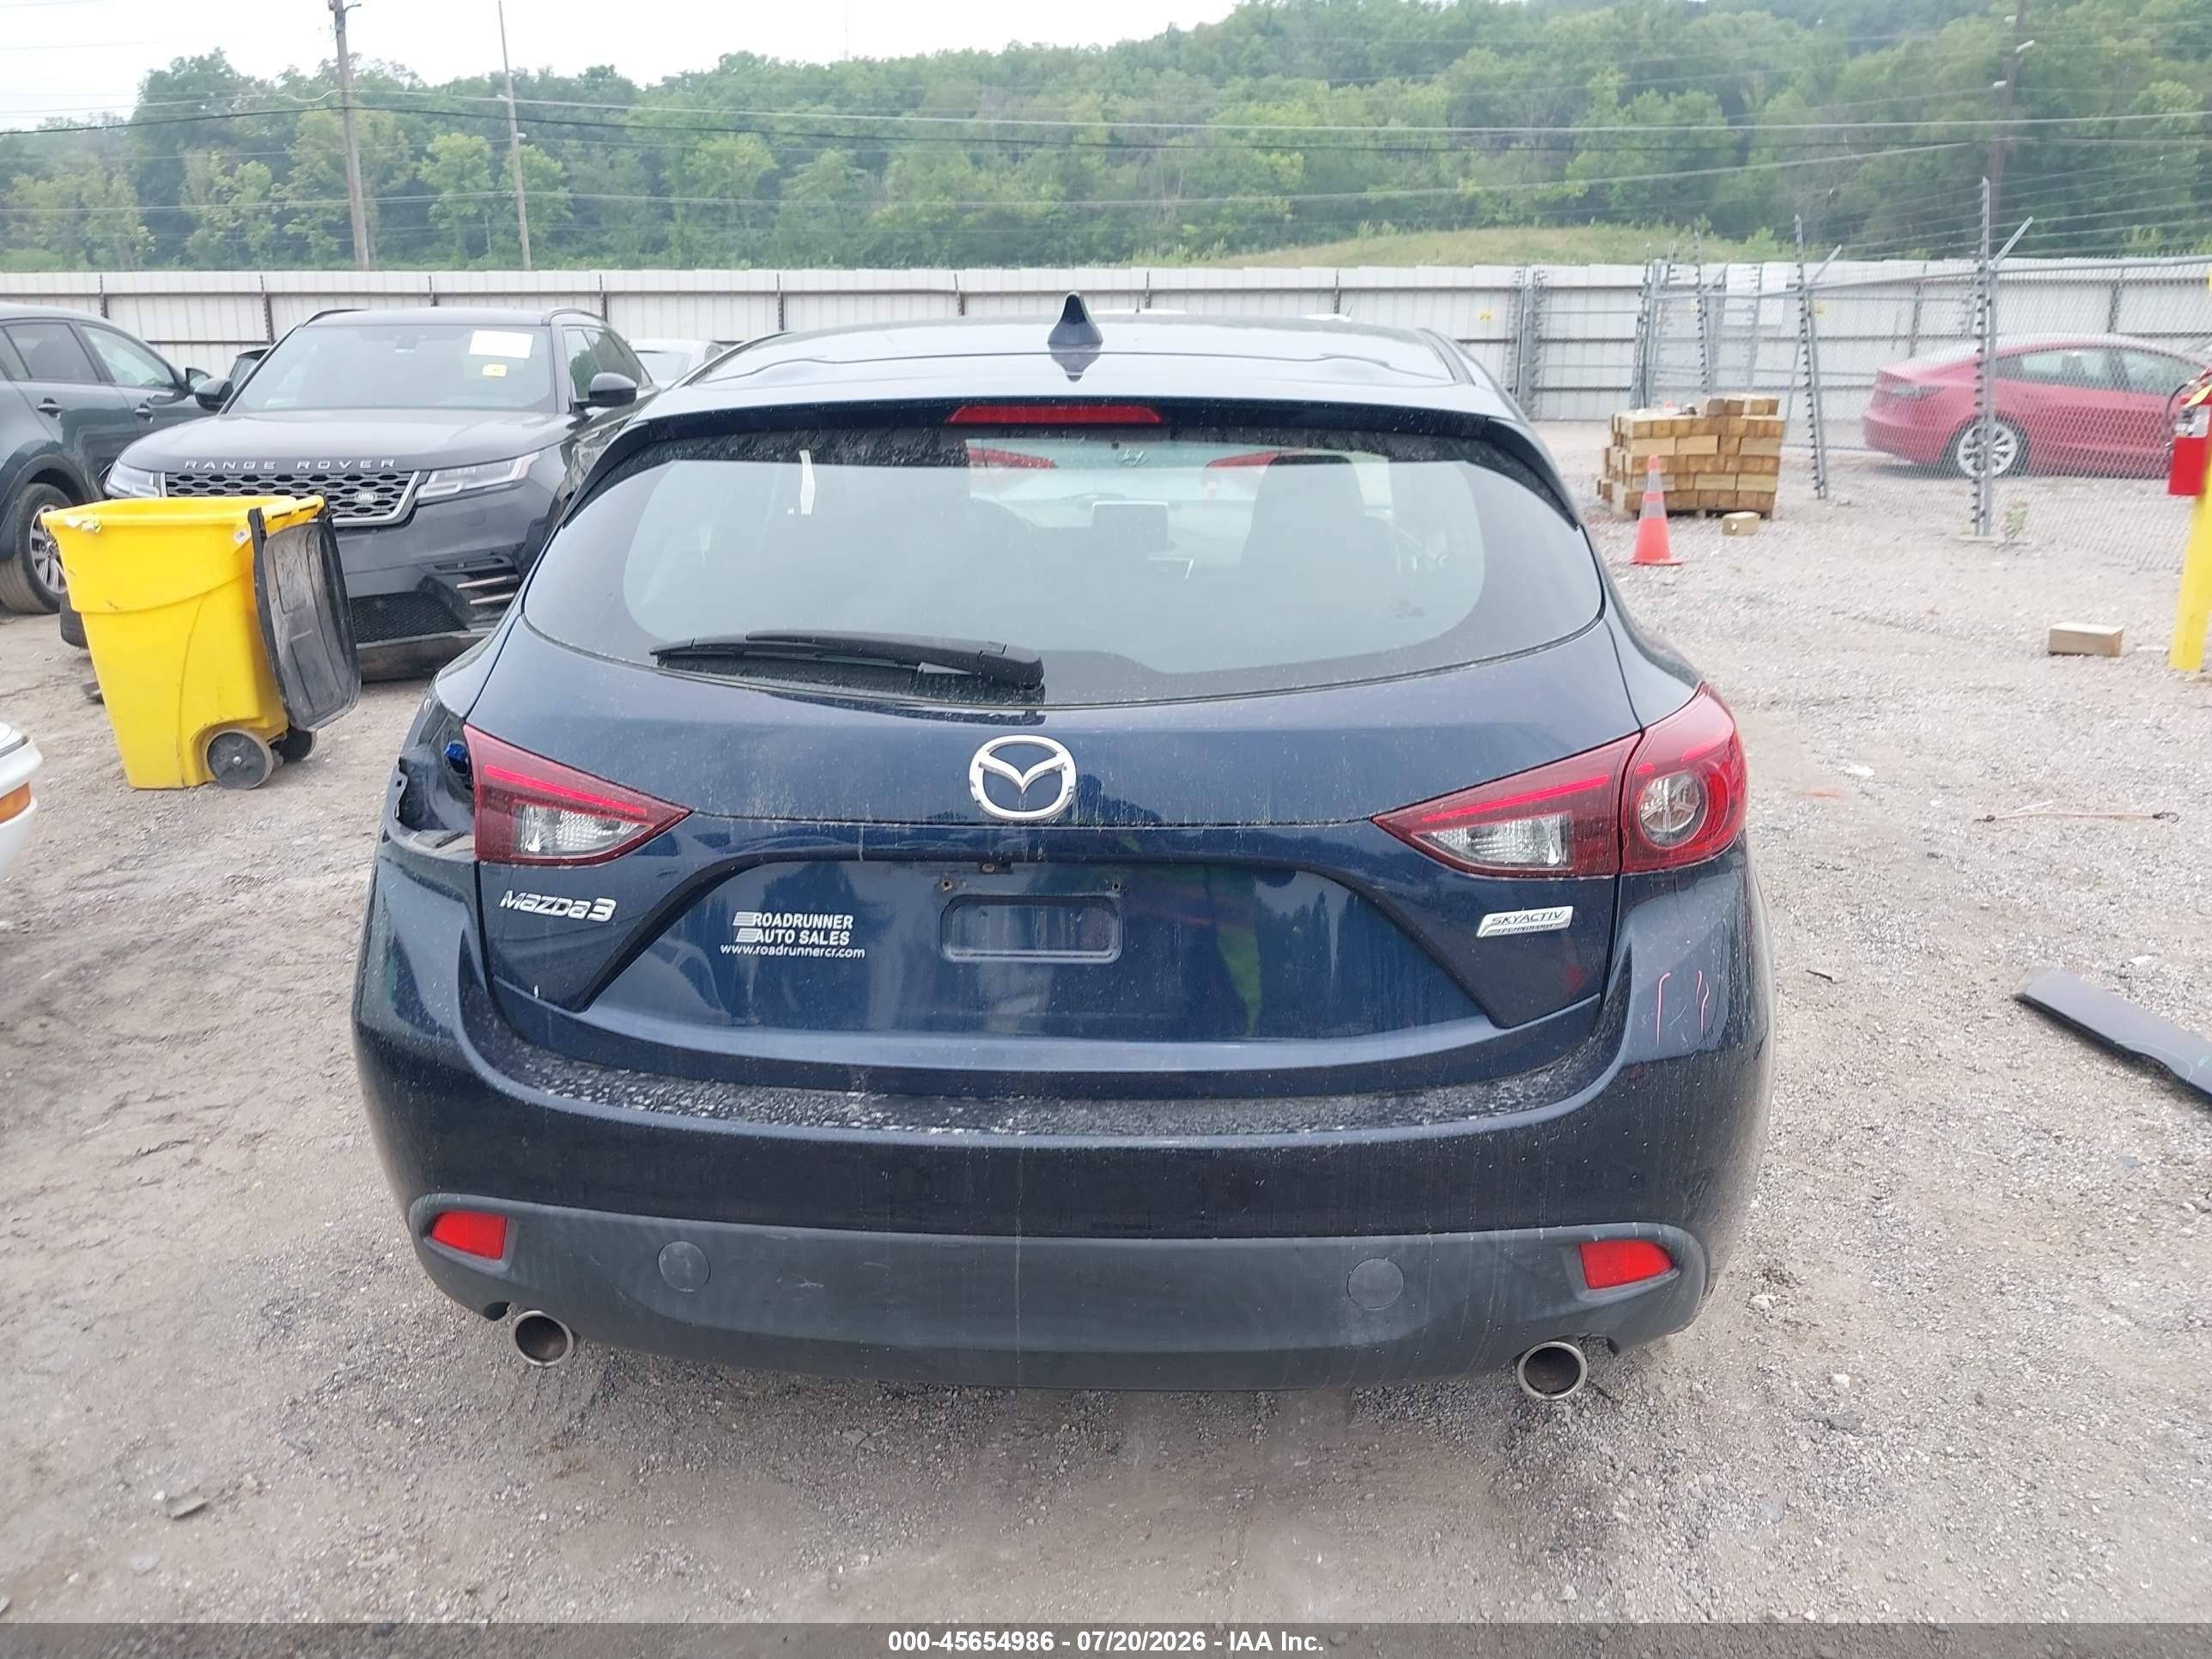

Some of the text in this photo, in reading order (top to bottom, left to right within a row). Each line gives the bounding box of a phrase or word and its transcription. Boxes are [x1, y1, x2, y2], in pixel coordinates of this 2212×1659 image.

[185, 459, 396, 470] RANGE ROVER
[752, 912, 854, 930] ROADRUNNER
[1492, 909, 1565, 926] SKYACTIV
[755, 928, 851, 946] AUTO SALES
[720, 944, 866, 959] www.roadrunnercr.com
